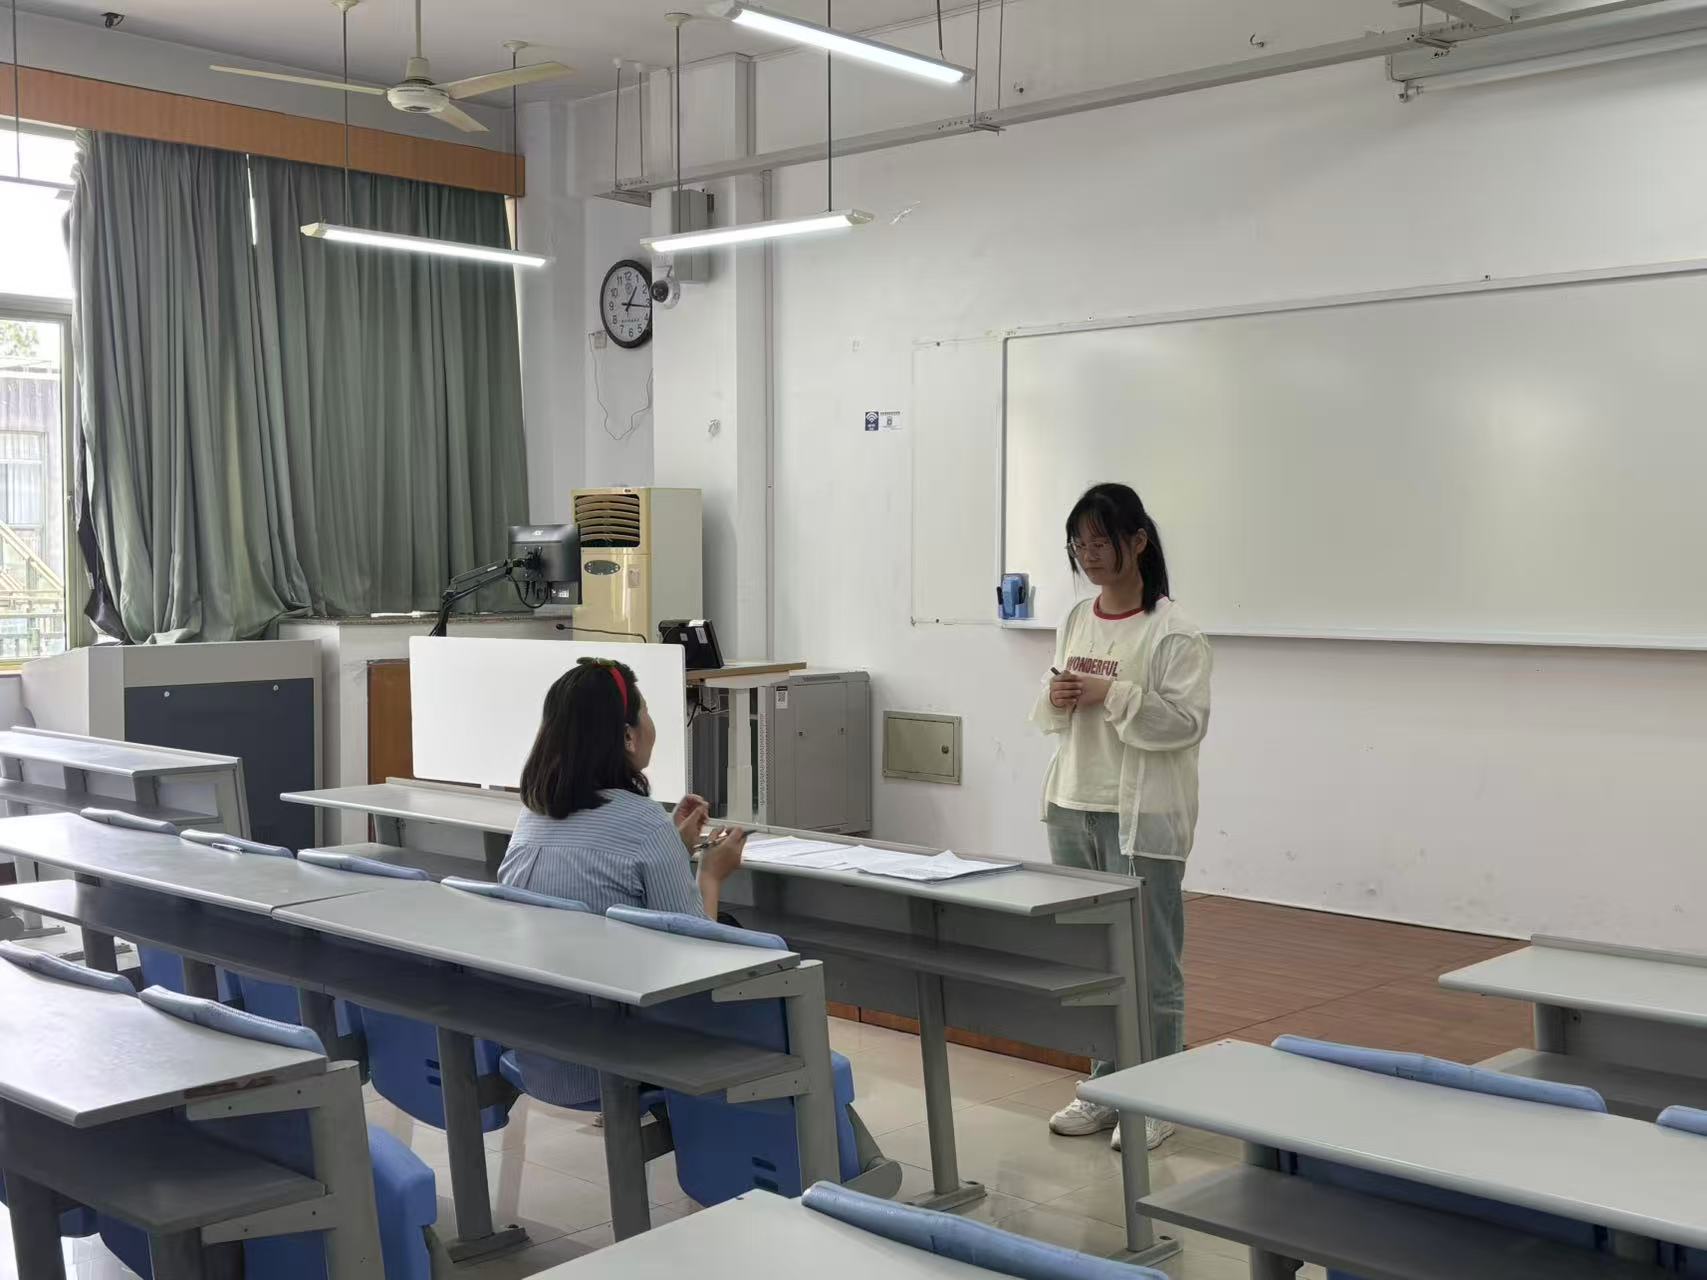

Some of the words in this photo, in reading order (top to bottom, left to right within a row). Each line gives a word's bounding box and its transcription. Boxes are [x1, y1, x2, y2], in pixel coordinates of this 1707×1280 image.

[617, 276, 622, 286] 11
[624, 271, 632, 281] 12
[642, 284, 648, 294] 2
[609, 301, 614, 311] 9
[612, 315, 617, 325] 8
[619, 324, 624, 334] 7
[628, 328, 634, 337] 6
[637, 323, 642, 334] 5
[1066, 656, 1119, 677] WONDERFUL
